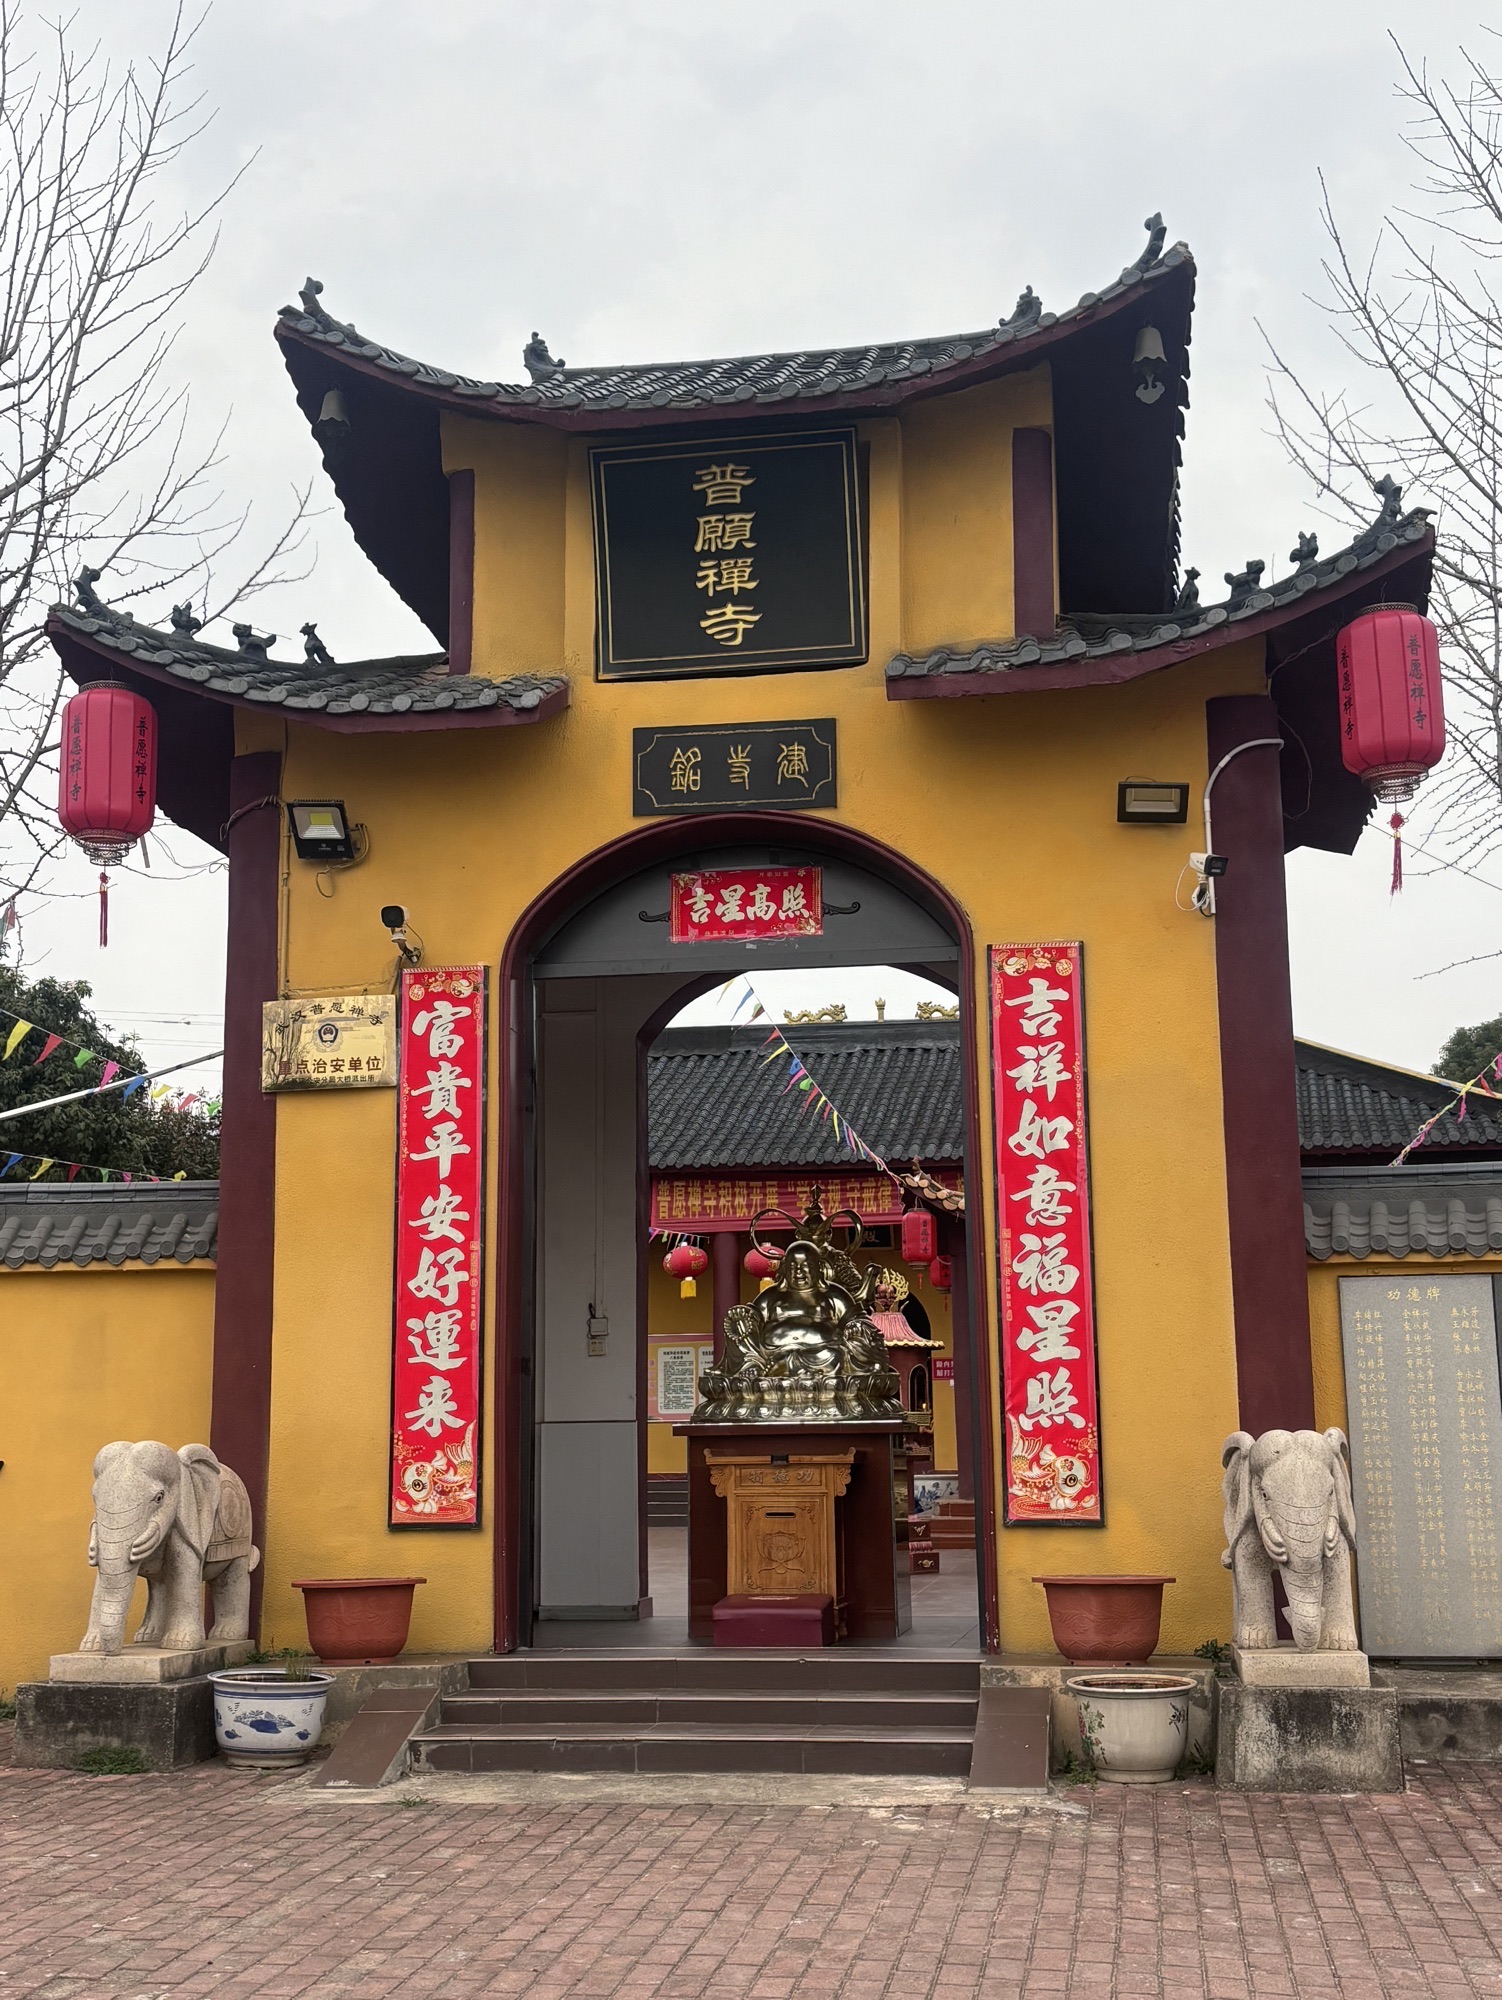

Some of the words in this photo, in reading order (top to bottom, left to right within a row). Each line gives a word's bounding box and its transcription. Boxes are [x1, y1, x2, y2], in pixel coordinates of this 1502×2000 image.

[684, 882, 810, 924] 吉星高照
[279, 1055, 382, 1076] 重点治安单位
[1004, 977, 1087, 1431] 吉祥如意福星照
[1387, 1286, 1441, 1302] 功德牌
